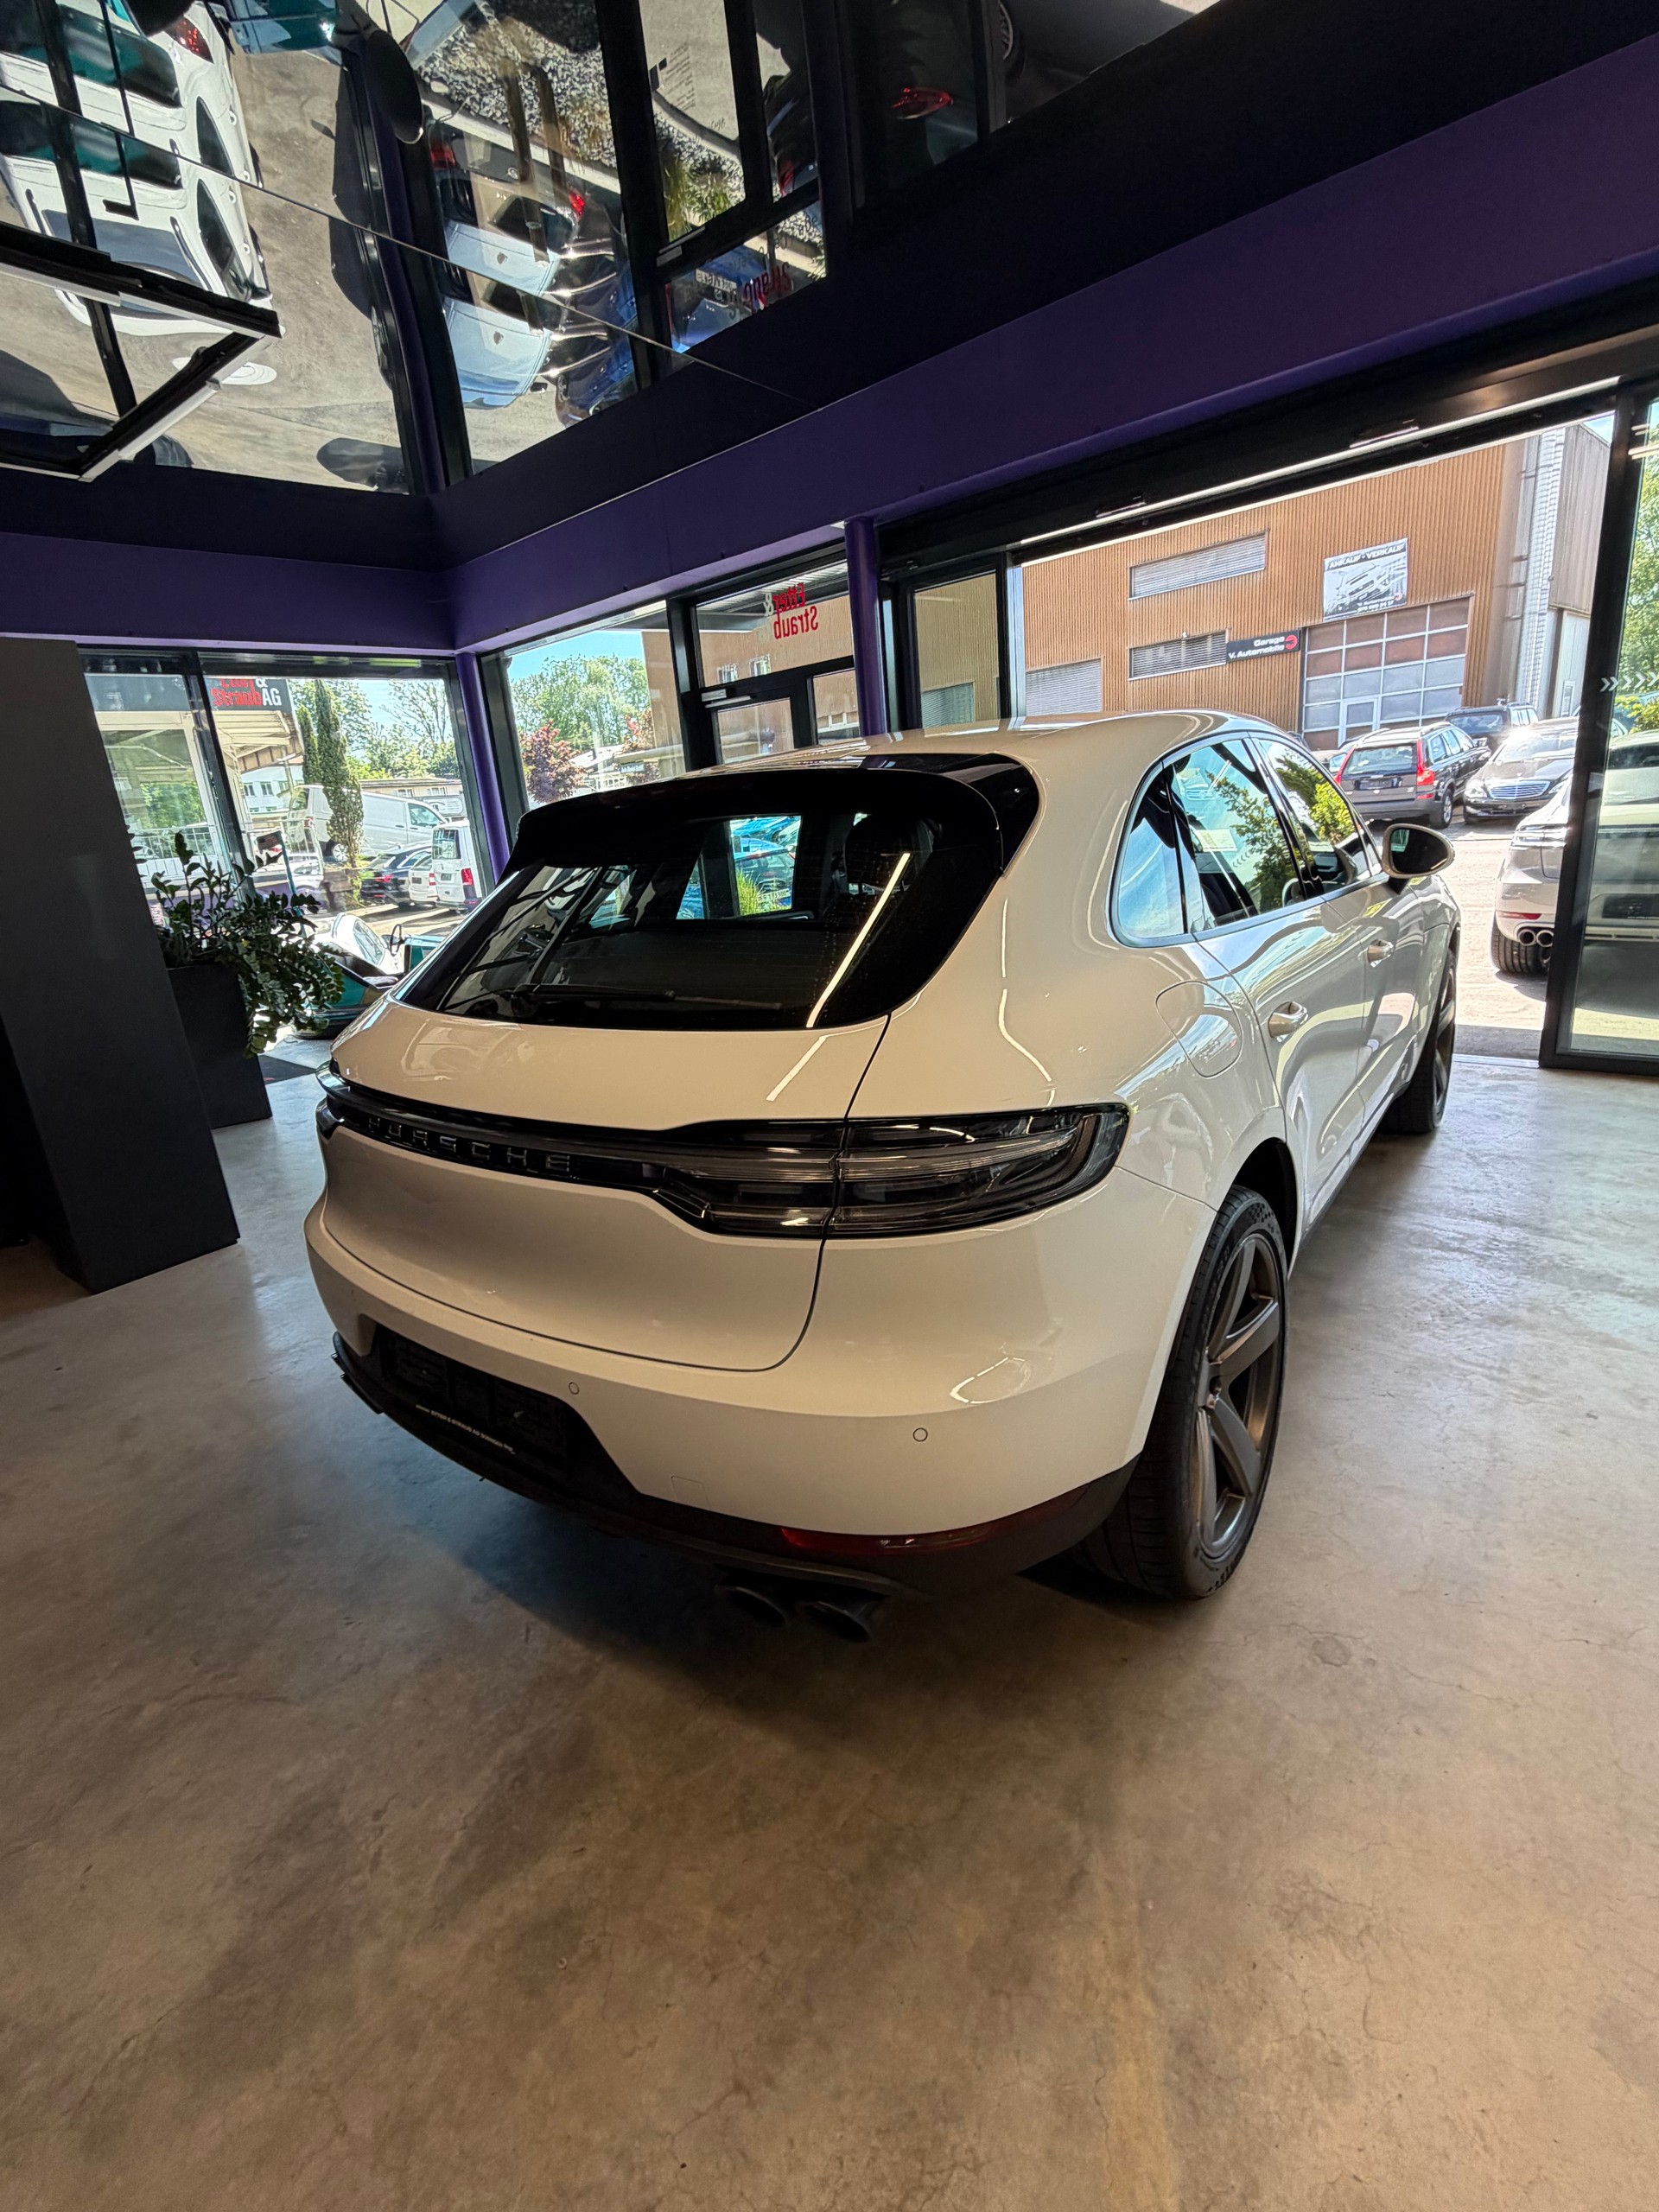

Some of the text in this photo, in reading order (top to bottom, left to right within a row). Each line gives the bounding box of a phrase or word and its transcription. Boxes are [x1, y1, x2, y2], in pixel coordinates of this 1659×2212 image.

[1329, 554, 1362, 569] ANKAUF
[1366, 544, 1404, 559] VERKAUF
[1253, 636, 1285, 647] Garage
[1237, 645, 1285, 658] Automobile
[210, 688, 283, 707] Straub AG
